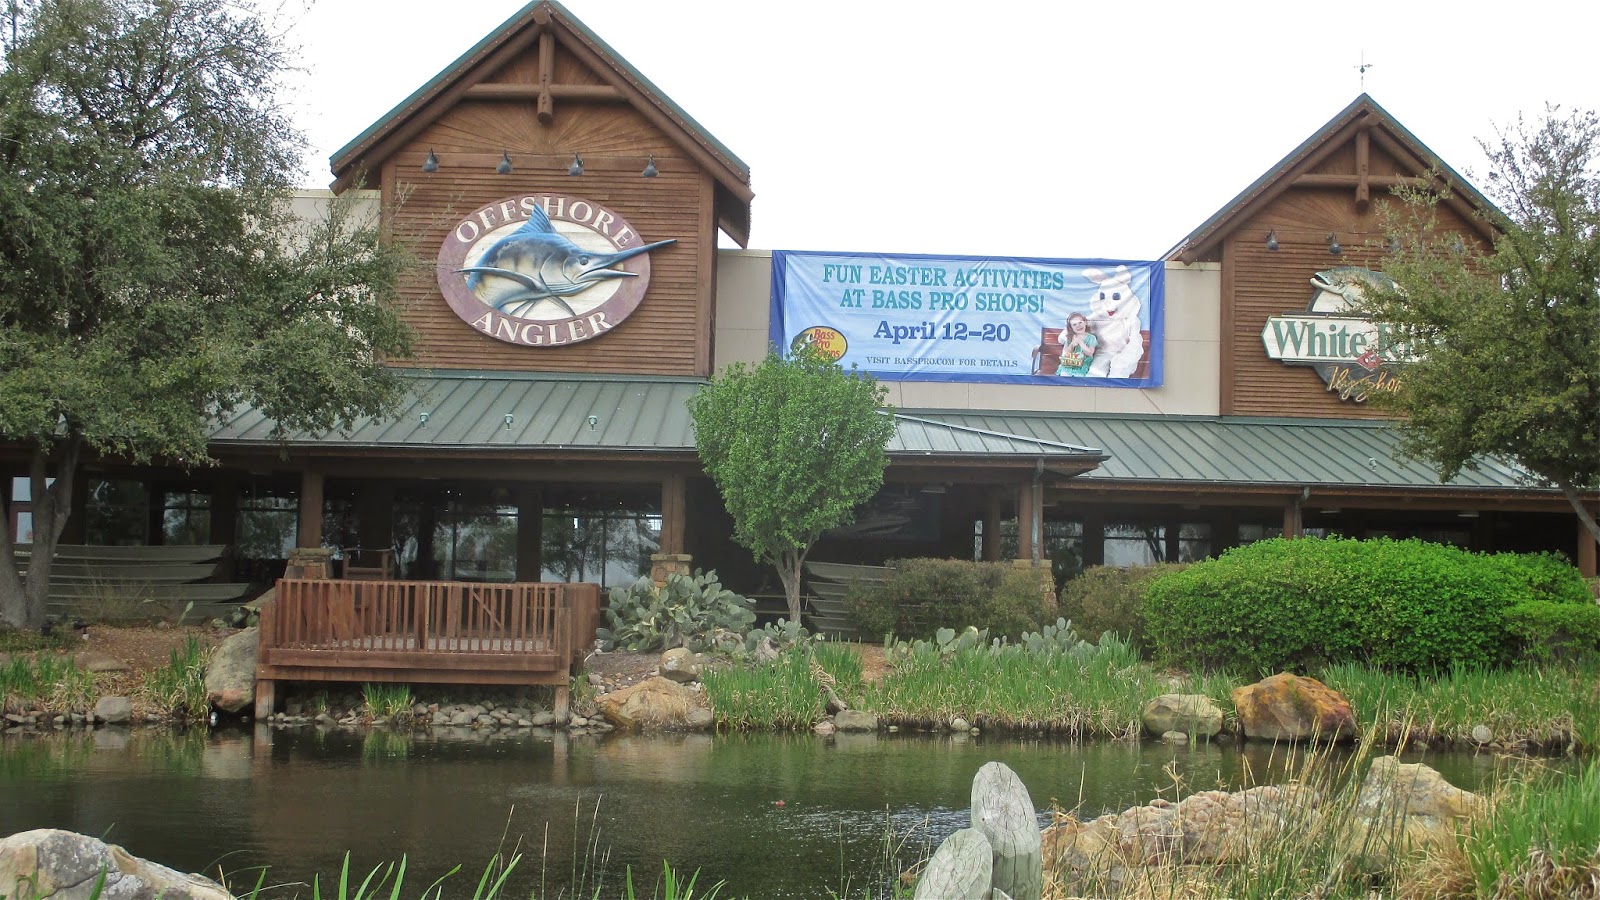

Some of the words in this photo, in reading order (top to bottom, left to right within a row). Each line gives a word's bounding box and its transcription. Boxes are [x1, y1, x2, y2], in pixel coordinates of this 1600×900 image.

[455, 196, 635, 249] OFFSHORE
[823, 264, 862, 283] FUN
[869, 266, 947, 287] EASTER
[953, 268, 1064, 290] ACTIVITIES
[840, 288, 865, 307] AT
[872, 290, 922, 310] BASS
[928, 292, 969, 310] PRO
[975, 293, 1045, 313] SHOPS!
[471, 311, 614, 345] ANGLER
[813, 328, 835, 340] Bass
[873, 320, 936, 345] April
[1270, 320, 1367, 357] White
[866, 356, 890, 364] VISIT
[894, 357, 955, 366] BASSPRO.COM
[959, 358, 977, 367] FOR
[980, 359, 1018, 367] DETAILS
